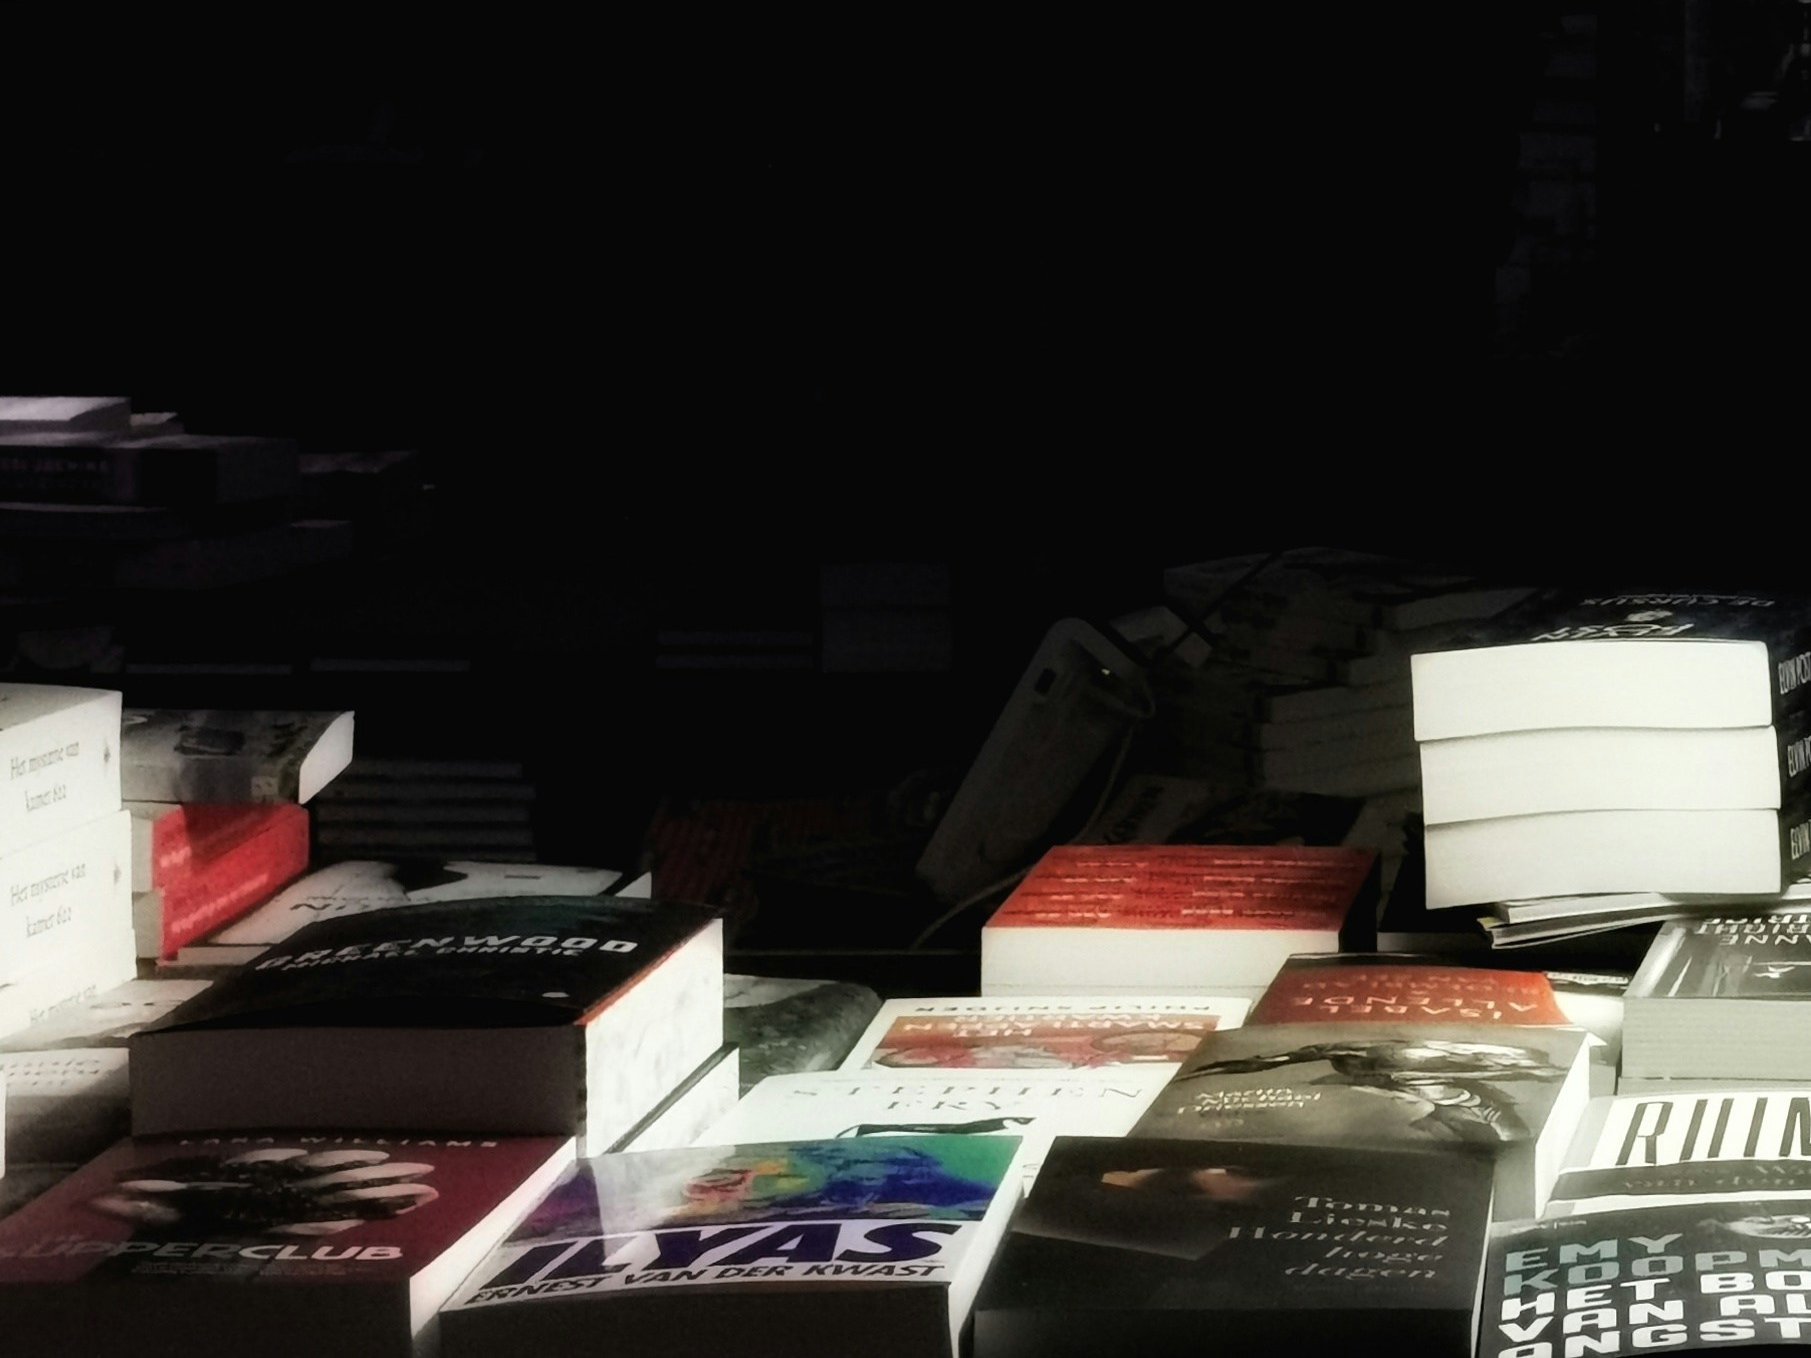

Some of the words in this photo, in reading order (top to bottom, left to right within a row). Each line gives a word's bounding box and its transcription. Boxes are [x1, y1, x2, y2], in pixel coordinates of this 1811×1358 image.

[254, 935, 640, 971] GREENWOOD
[1290, 1212, 1449, 1231] Lieske
[1293, 1195, 1451, 1218] Tomas
[1228, 1225, 1449, 1247] Honderd
[1505, 1231, 1683, 1273] EMY
[478, 1222, 963, 1291] ILYAS
[1284, 1262, 1437, 1282] dagen
[463, 1275, 606, 1305] ERNEST
[625, 1269, 710, 1287] VAN
[716, 1264, 793, 1279] DER
[803, 1263, 946, 1278] KWAST
[1499, 1277, 1673, 1321] HET
[1498, 1299, 1686, 1344] VAN
